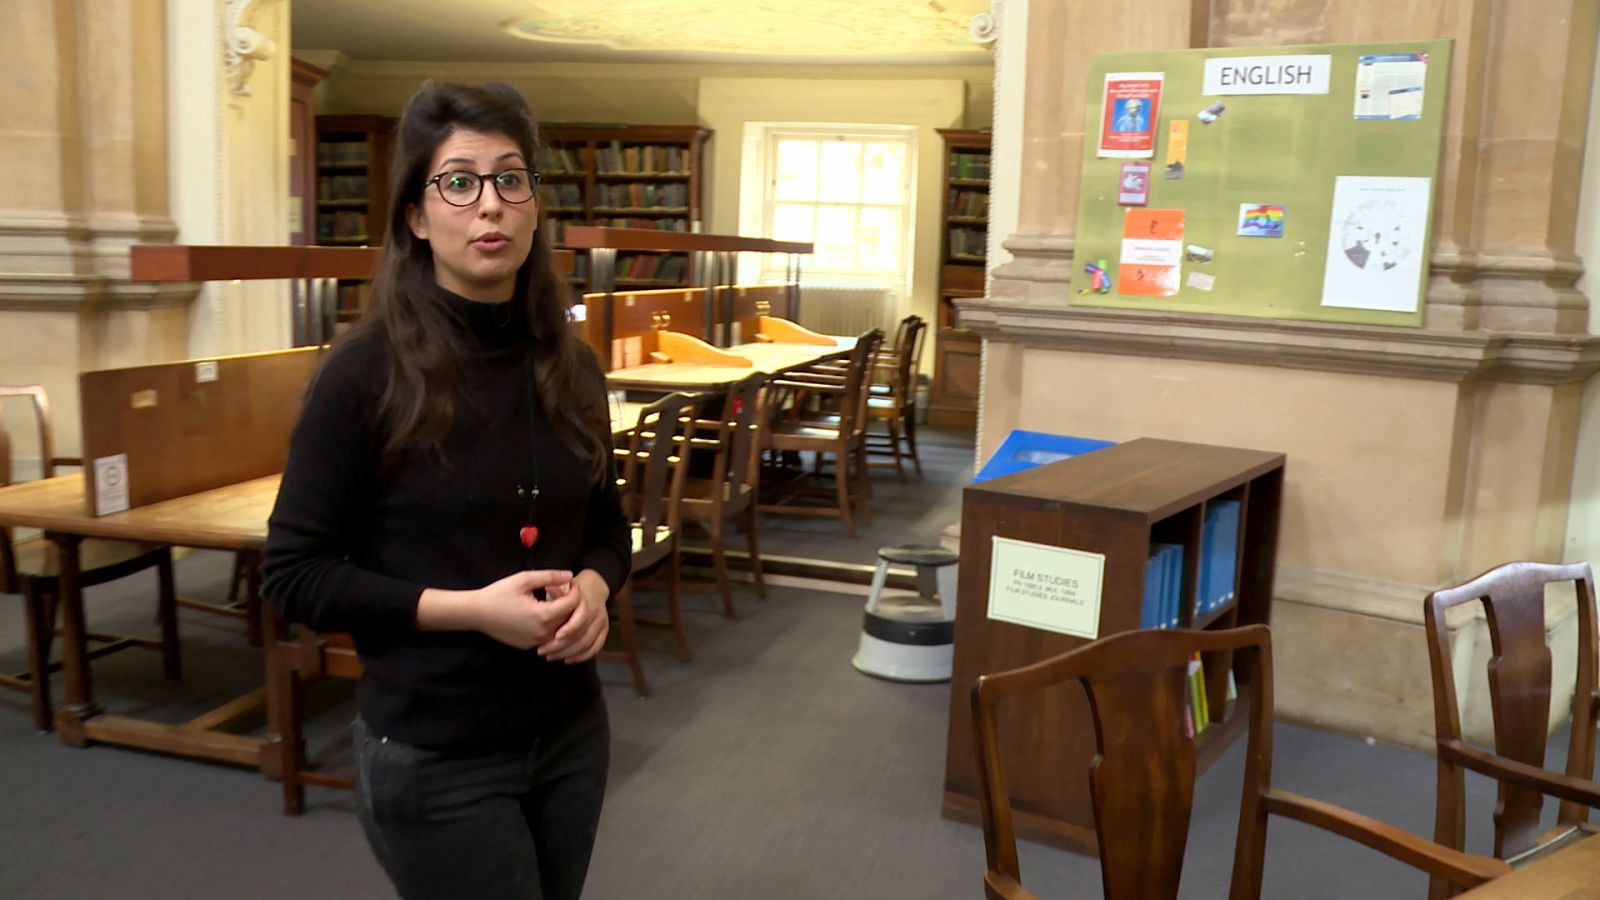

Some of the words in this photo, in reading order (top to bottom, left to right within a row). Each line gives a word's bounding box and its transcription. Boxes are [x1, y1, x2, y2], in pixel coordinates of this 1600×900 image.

[1220, 65, 1312, 86] ENGLISH
[1013, 568, 1035, 580] FILM
[1037, 573, 1079, 589] STUDIES
[1021, 588, 1048, 599] STUDIES
